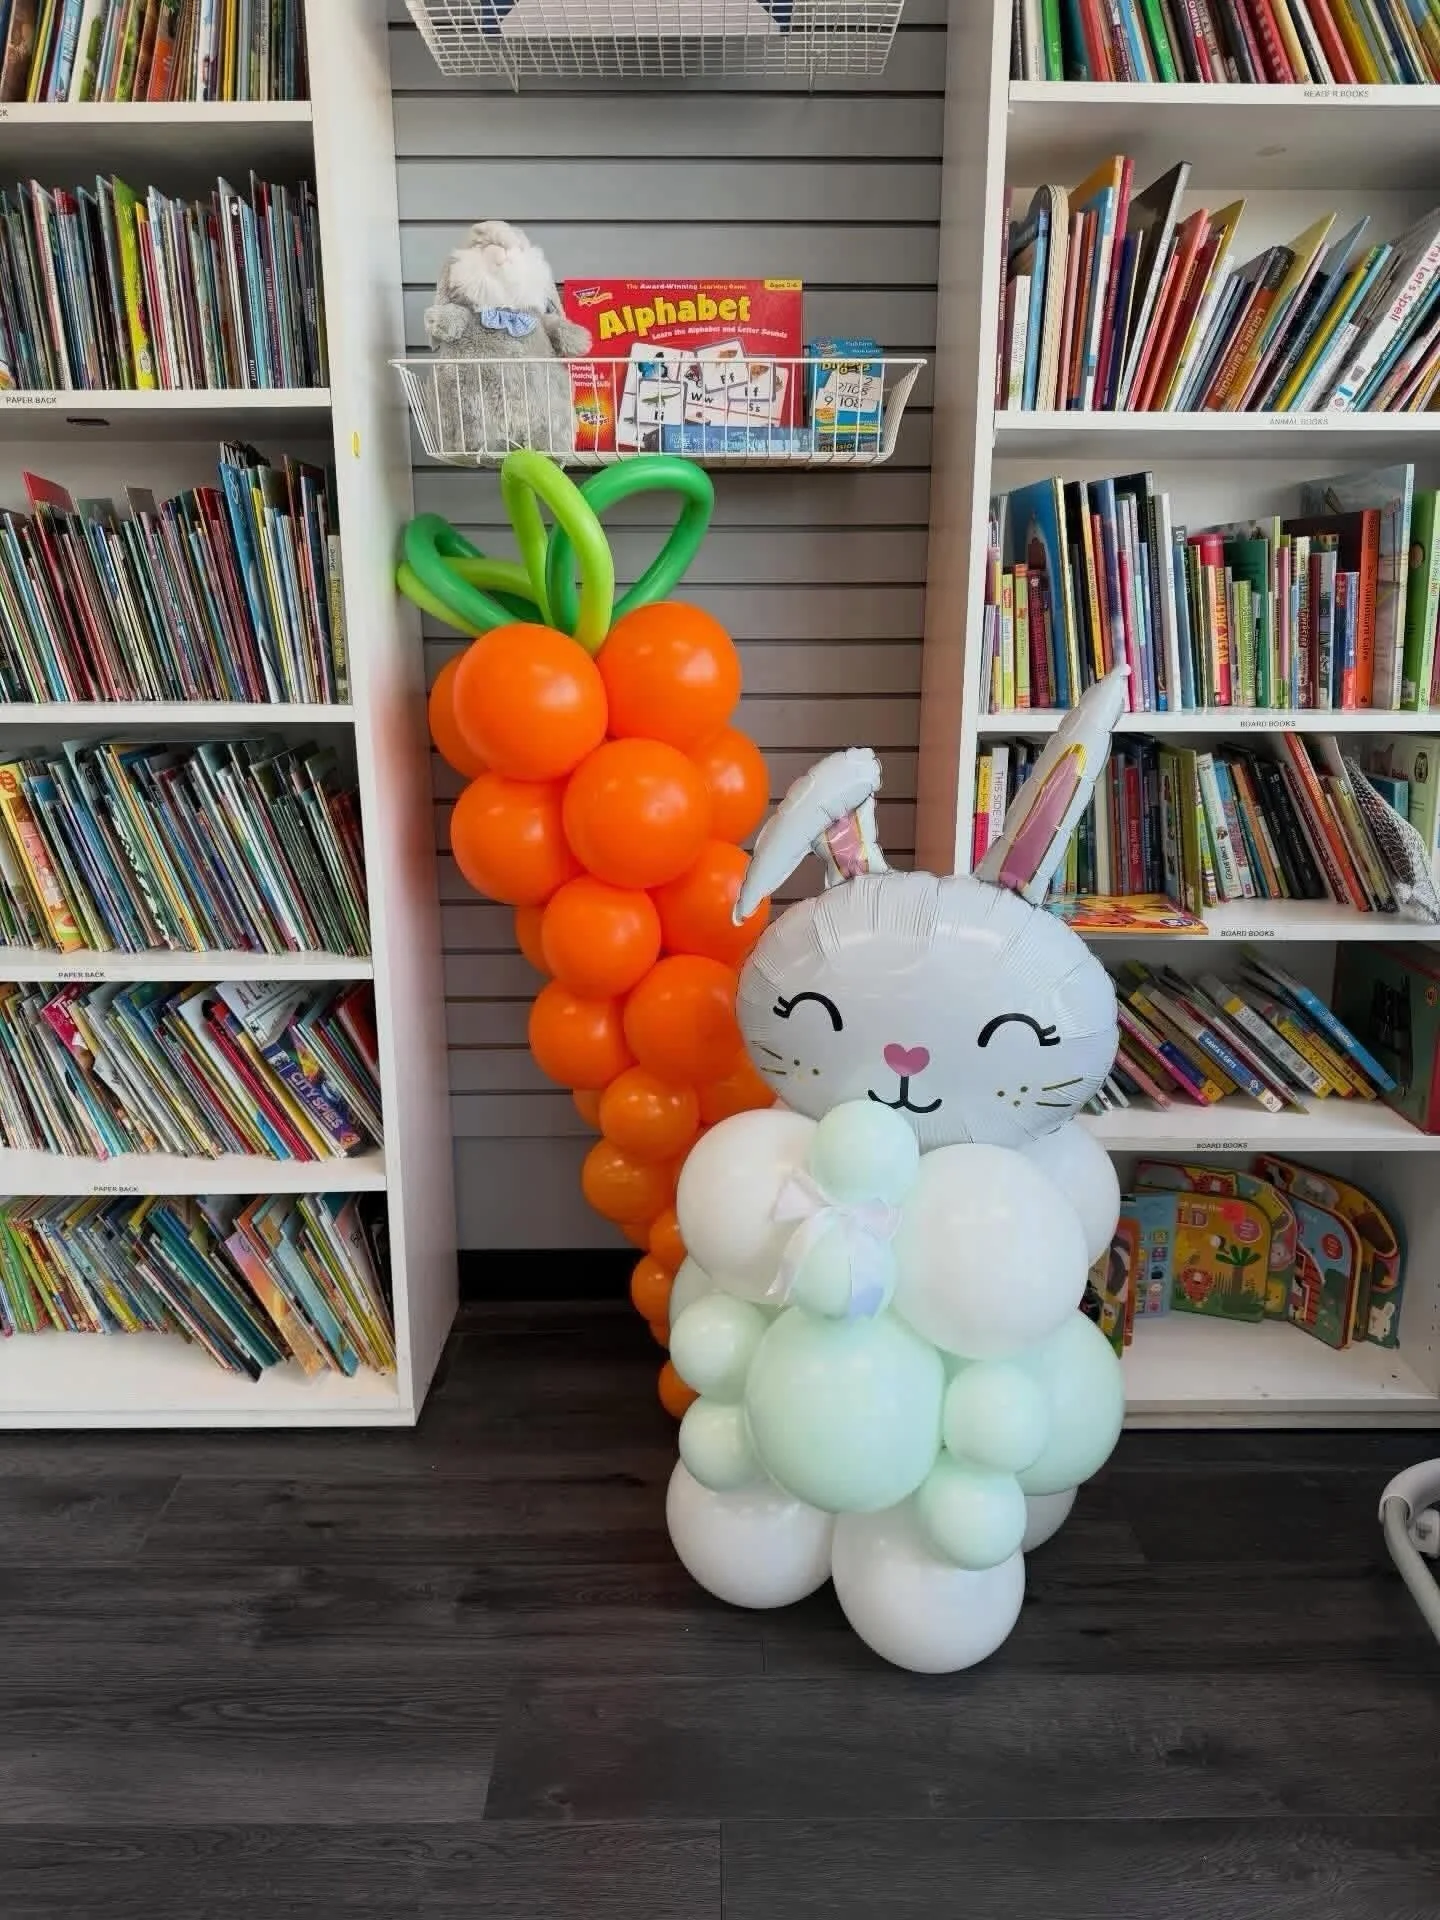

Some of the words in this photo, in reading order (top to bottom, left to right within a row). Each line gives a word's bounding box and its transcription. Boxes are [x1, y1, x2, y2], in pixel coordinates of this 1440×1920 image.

[639, 283, 698, 291] Award-Winning
[599, 293, 752, 341] Alphabet
[1390, 289, 1413, 323] Spell
[651, 331, 673, 341] Learn
[687, 326, 721, 335] Alphabet
[737, 326, 760, 335] Letter
[760, 328, 788, 339] Sounds
[6, 396, 33, 404] PAPER
[35, 396, 57, 404] BACK
[994, 770, 1004, 793] THIS
[993, 794, 1003, 817] SIDE
[290, 1070, 319, 1099] CITY
[313, 1094, 343, 1130] SPIES
